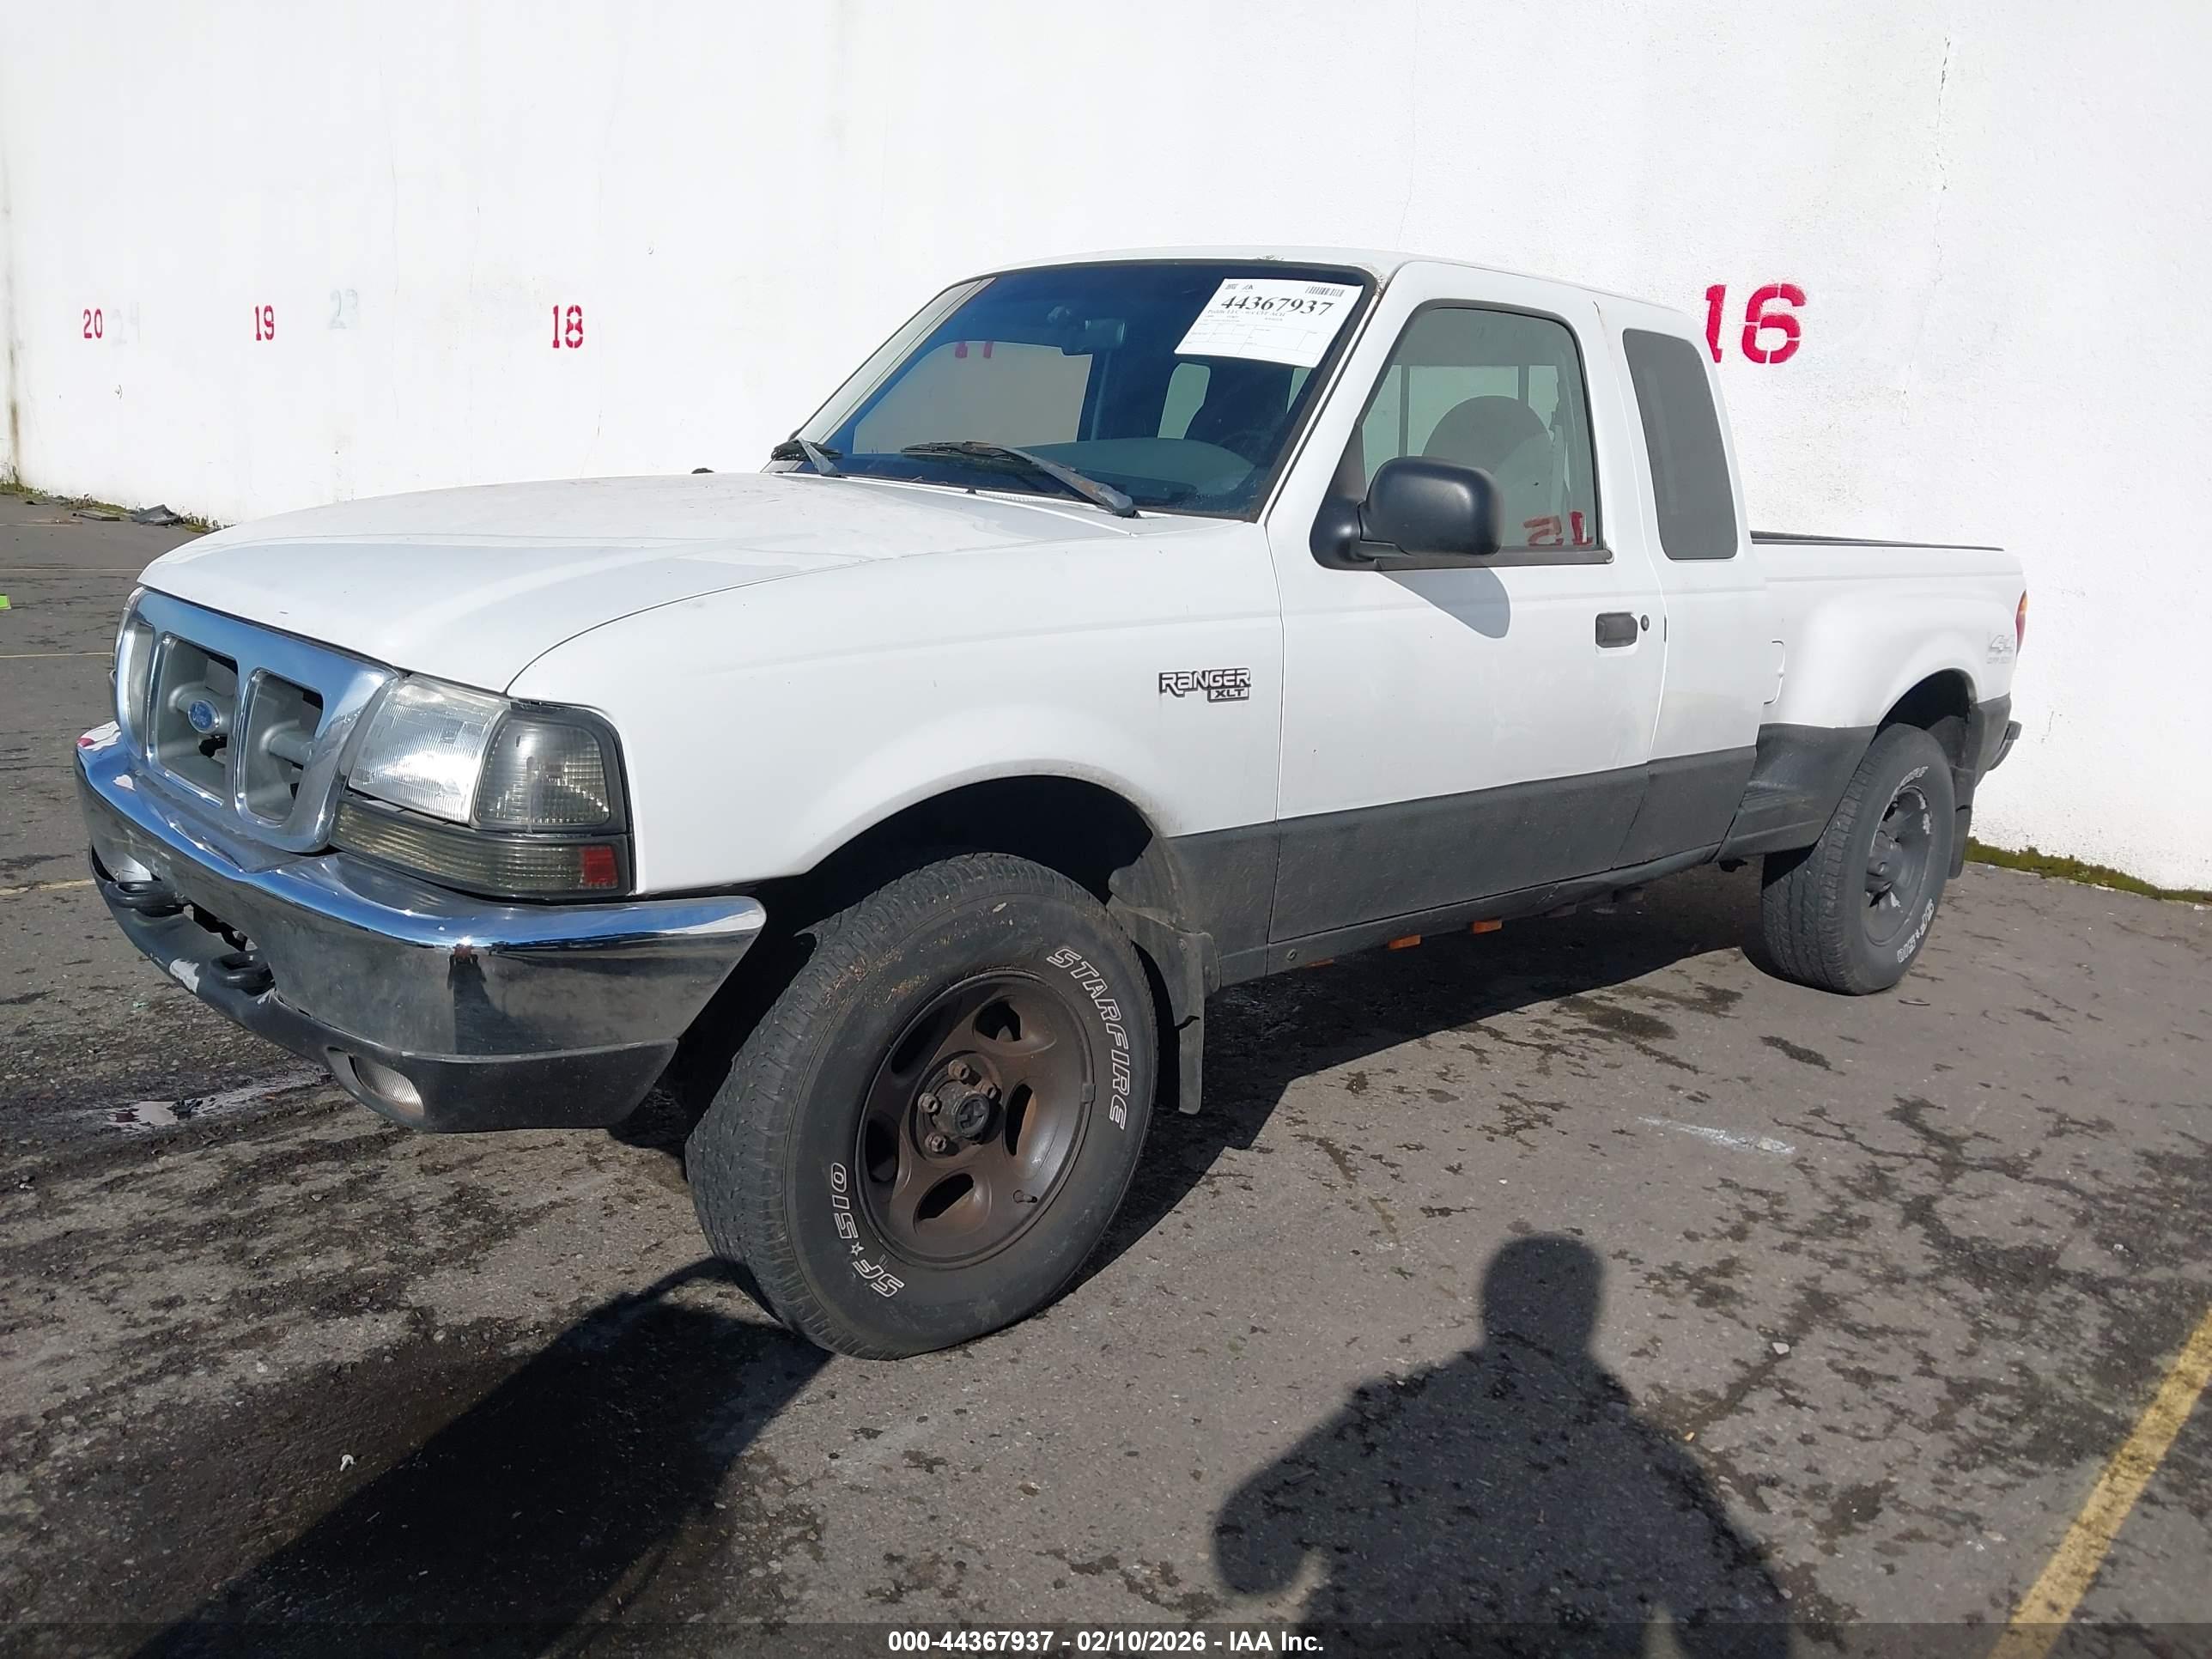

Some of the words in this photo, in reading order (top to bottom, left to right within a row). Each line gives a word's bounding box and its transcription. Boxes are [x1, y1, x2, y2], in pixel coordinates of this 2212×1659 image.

[1221, 295, 1335, 315] 44367937
[83, 308, 103, 338] 20
[255, 305, 274, 341] 19
[552, 304, 583, 349] 18
[1705, 283, 1807, 364] 16
[1158, 668, 1250, 697] RANGER
[1214, 689, 1245, 698] XLT
[1047, 948, 1130, 1130] STARFIRE
